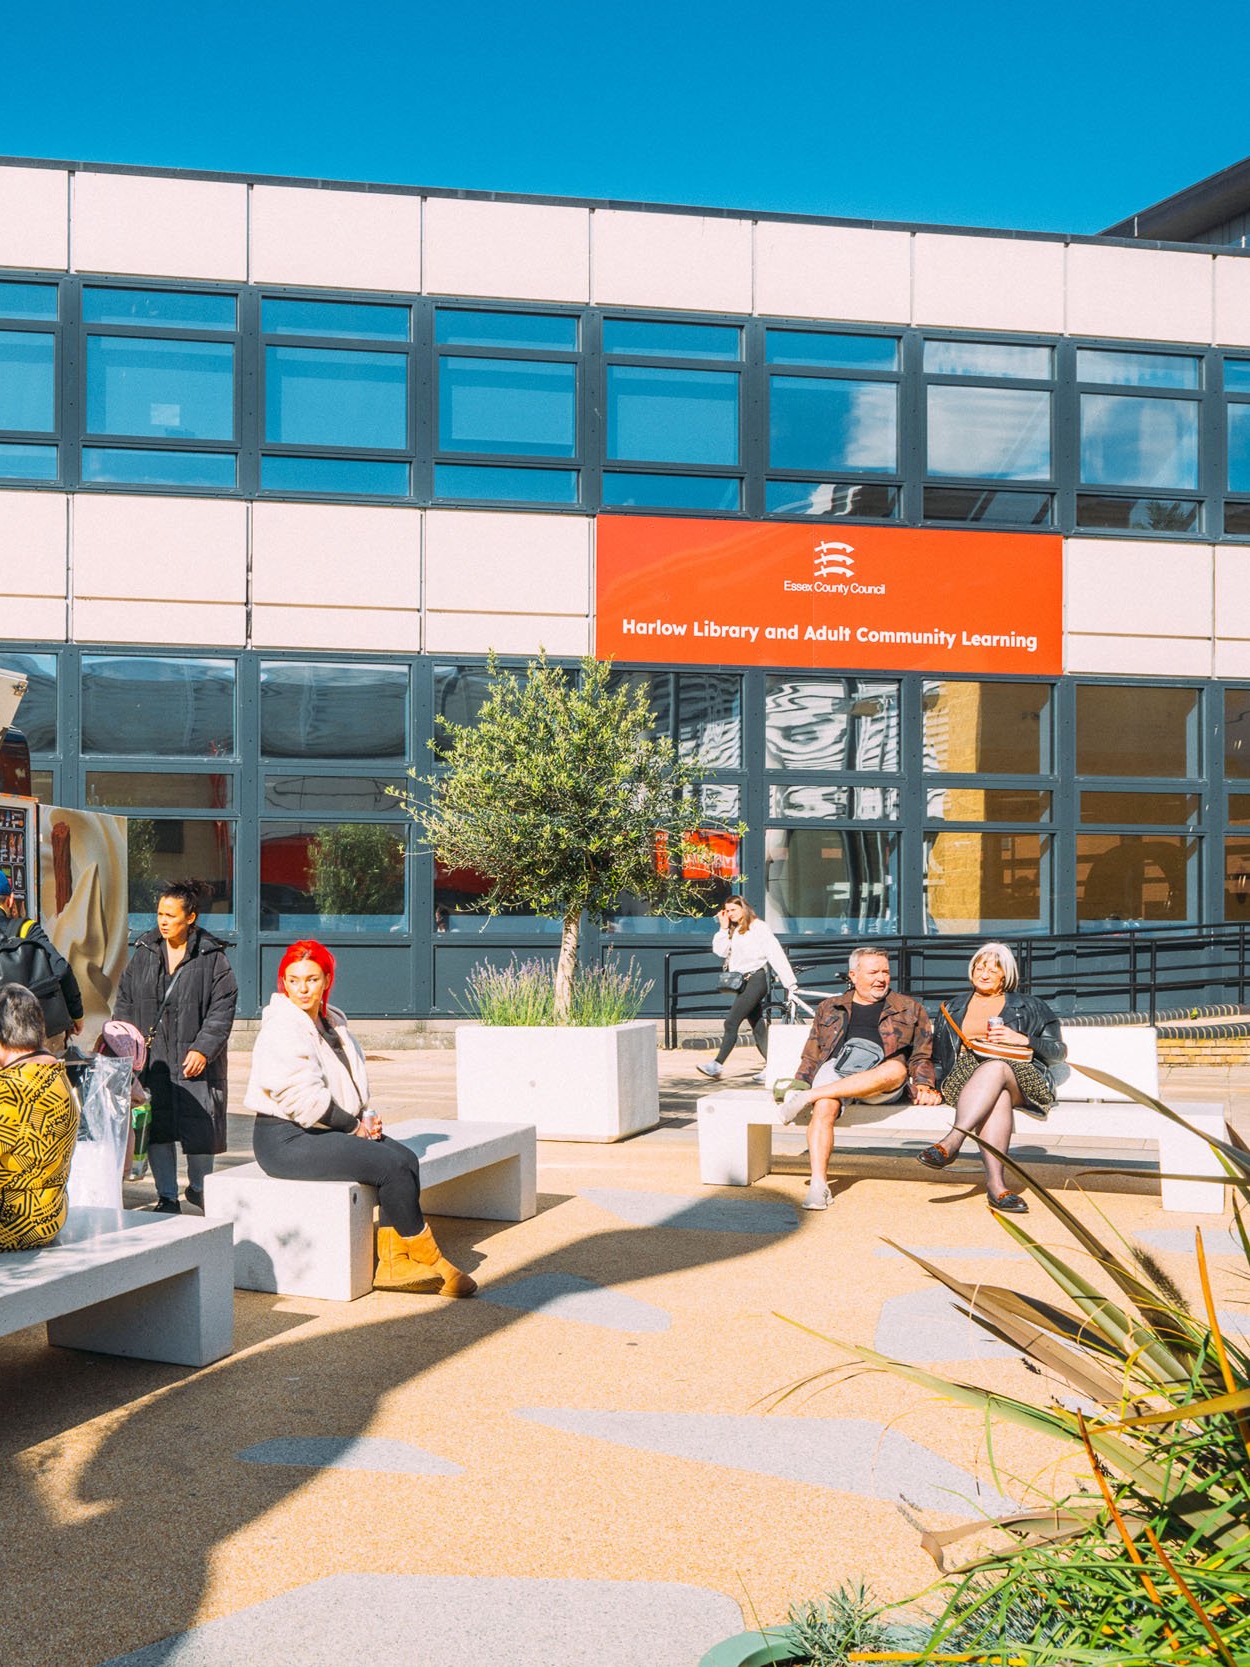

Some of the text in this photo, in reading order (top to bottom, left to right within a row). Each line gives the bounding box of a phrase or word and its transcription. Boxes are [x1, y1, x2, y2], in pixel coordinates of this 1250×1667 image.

[783, 580, 886, 595] Essex County Council
[622, 618, 1038, 653] Harlow Library and Adult Community Learning
